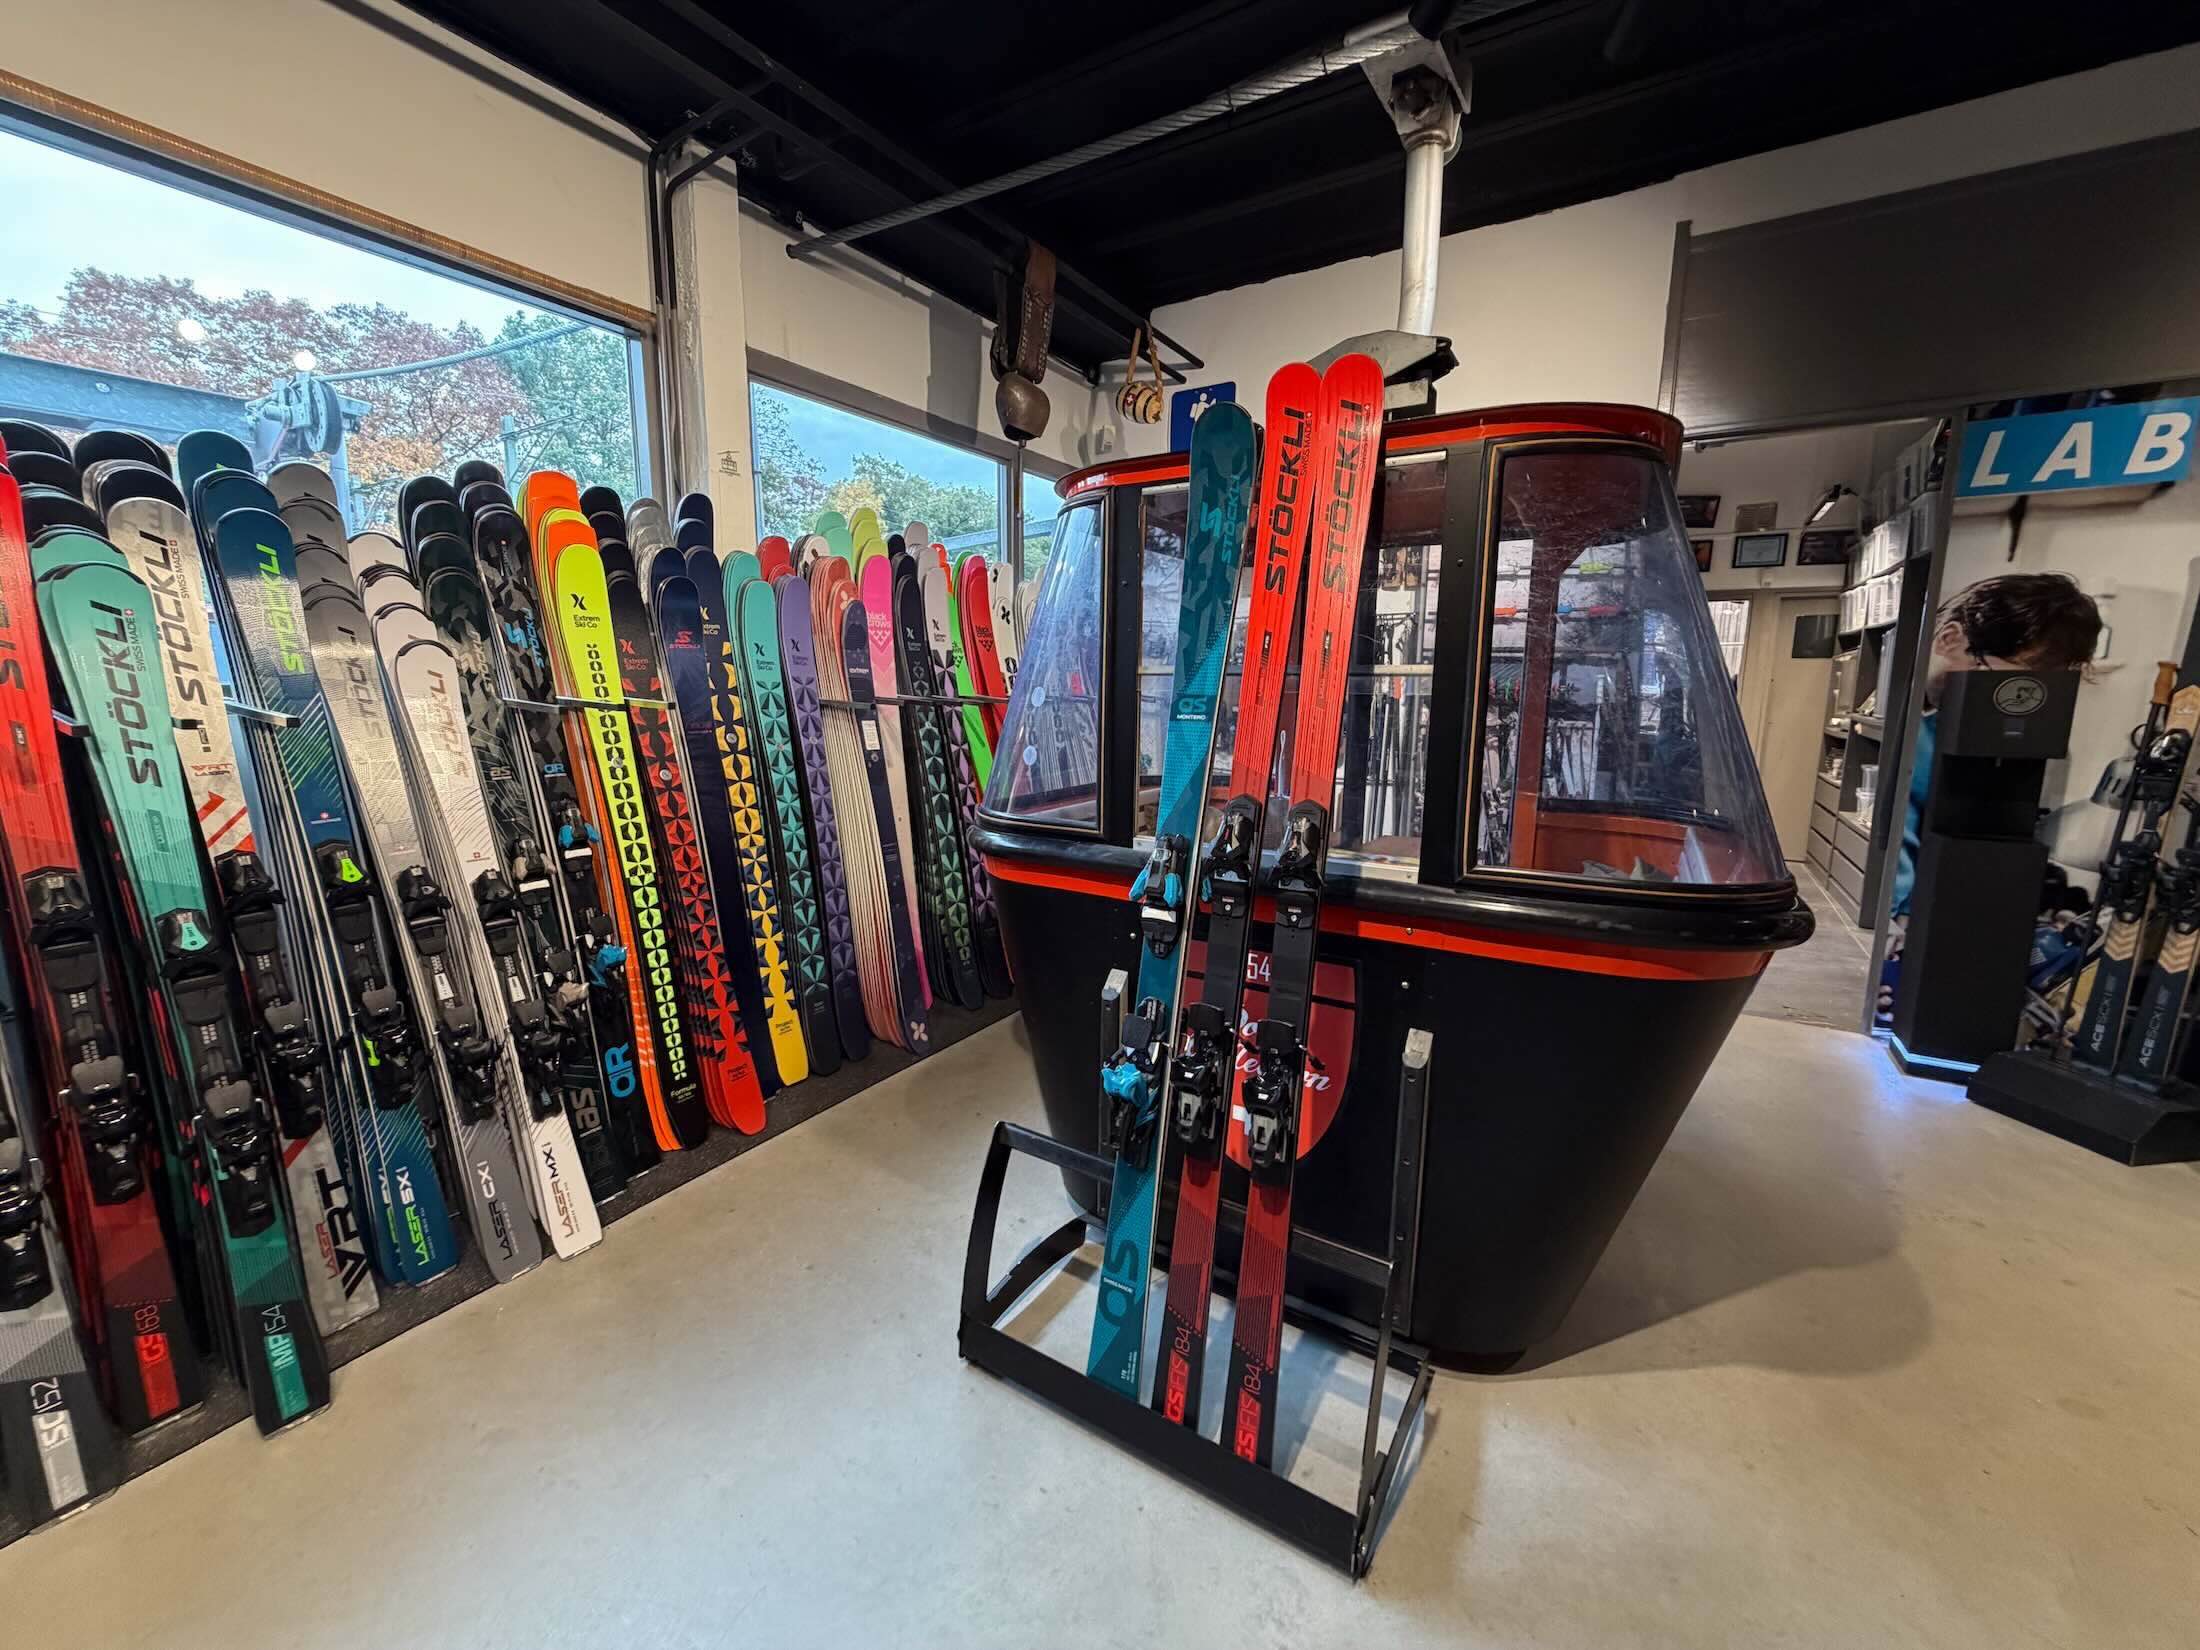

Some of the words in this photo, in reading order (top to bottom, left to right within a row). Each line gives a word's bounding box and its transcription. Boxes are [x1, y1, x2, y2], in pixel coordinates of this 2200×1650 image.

[1304, 421, 1313, 449] MADE
[1265, 407, 1305, 595] STÖCKLI
[1323, 400, 1363, 593] STÖCKLI
[170, 547, 184, 574] MADE
[126, 616, 140, 643] MADE
[139, 530, 208, 706] STÖCKLI
[132, 645, 147, 673] SWISS
[90, 600, 163, 788] STÖCKLI
[671, 1083, 697, 1097] Formula
[405, 1203, 431, 1266] LASER
[489, 1199, 513, 1261] LASER
[552, 1179, 575, 1238] LASER
[315, 1222, 342, 1280] LASER
[1174, 1325, 1192, 1357] 184
[1243, 1363, 1263, 1395] 184
